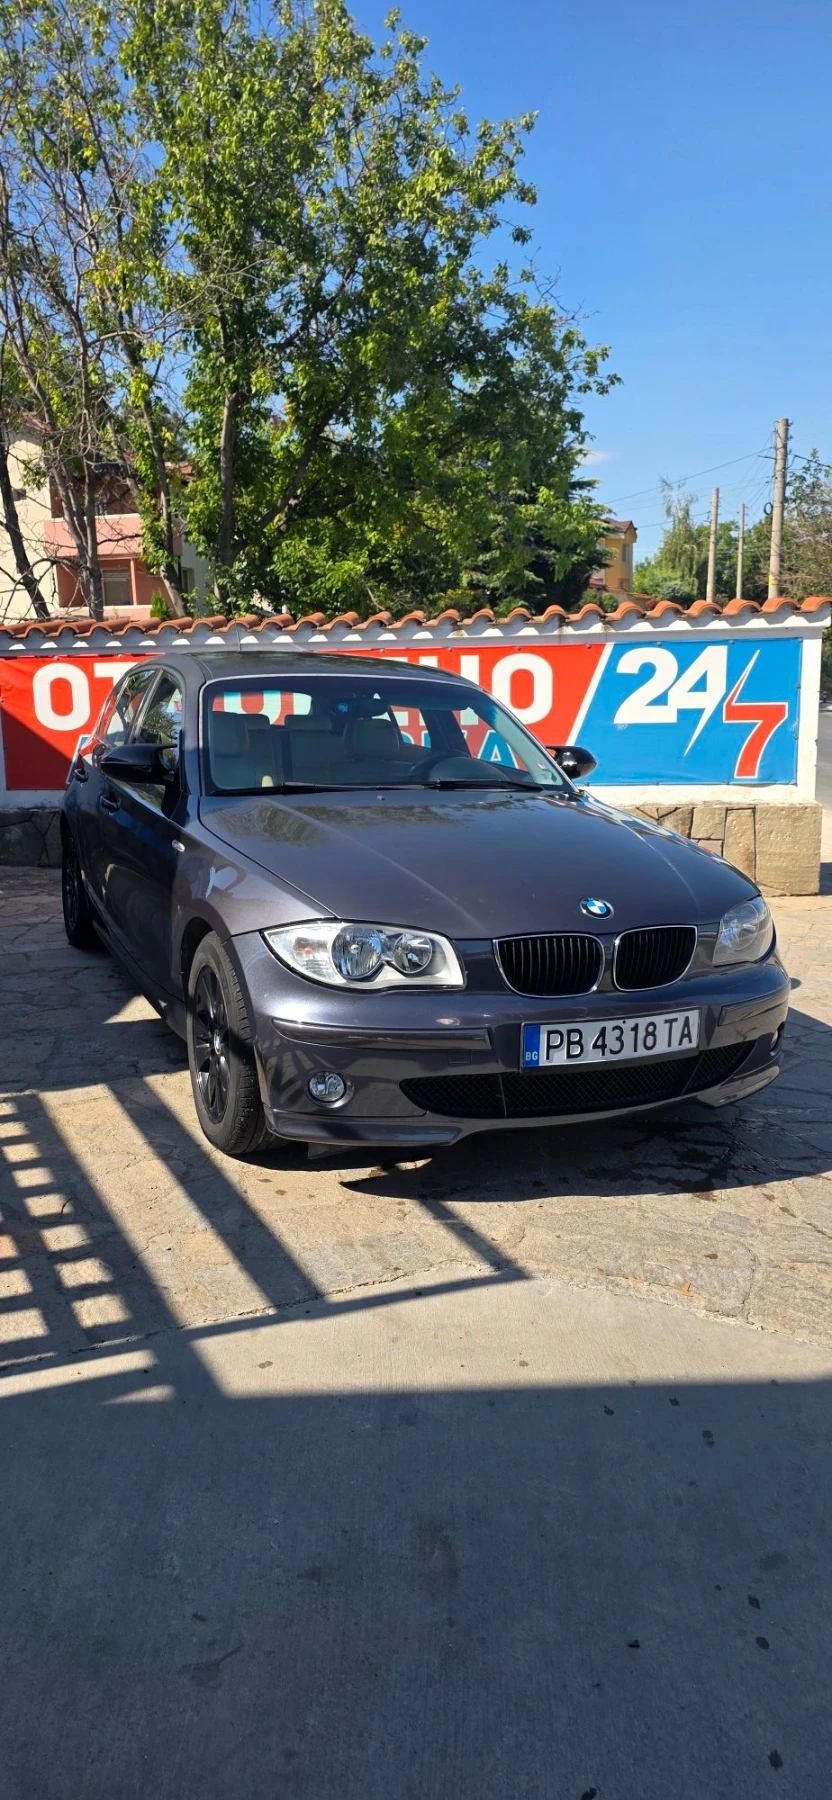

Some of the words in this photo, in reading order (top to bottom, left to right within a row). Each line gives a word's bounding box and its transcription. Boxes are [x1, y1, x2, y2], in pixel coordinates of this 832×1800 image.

[525, 1052, 539, 1061] BG
[545, 1028, 584, 1061] PB
[591, 1021, 657, 1057] 4318
[664, 1016, 693, 1048] TA
